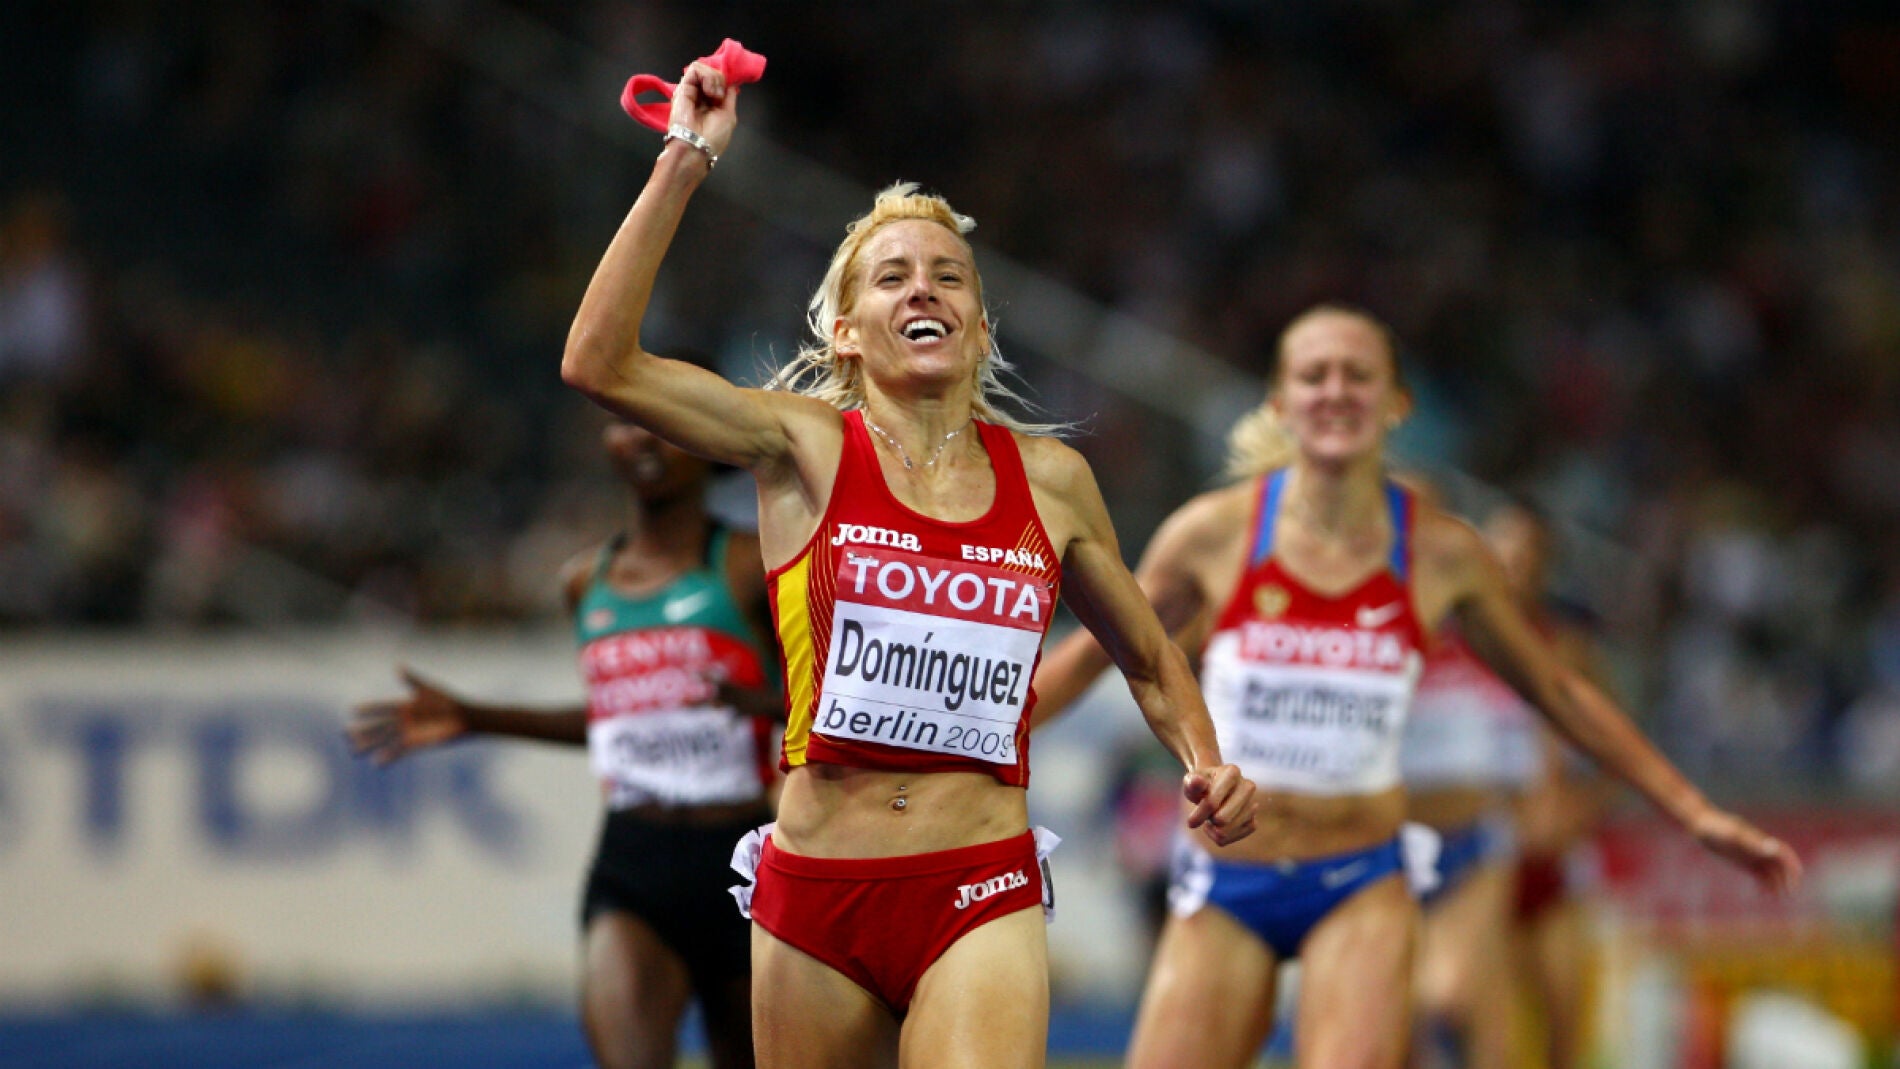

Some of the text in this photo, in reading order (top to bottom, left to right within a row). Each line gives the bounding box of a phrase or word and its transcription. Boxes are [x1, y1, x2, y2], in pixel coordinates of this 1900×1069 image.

[961, 543, 1046, 570] ESPAÑA
[847, 556, 1041, 622] TOYOTA
[835, 618, 1023, 711] Domínguez
[1242, 622, 1403, 669] TOYOTA
[823, 699, 939, 747] berlin
